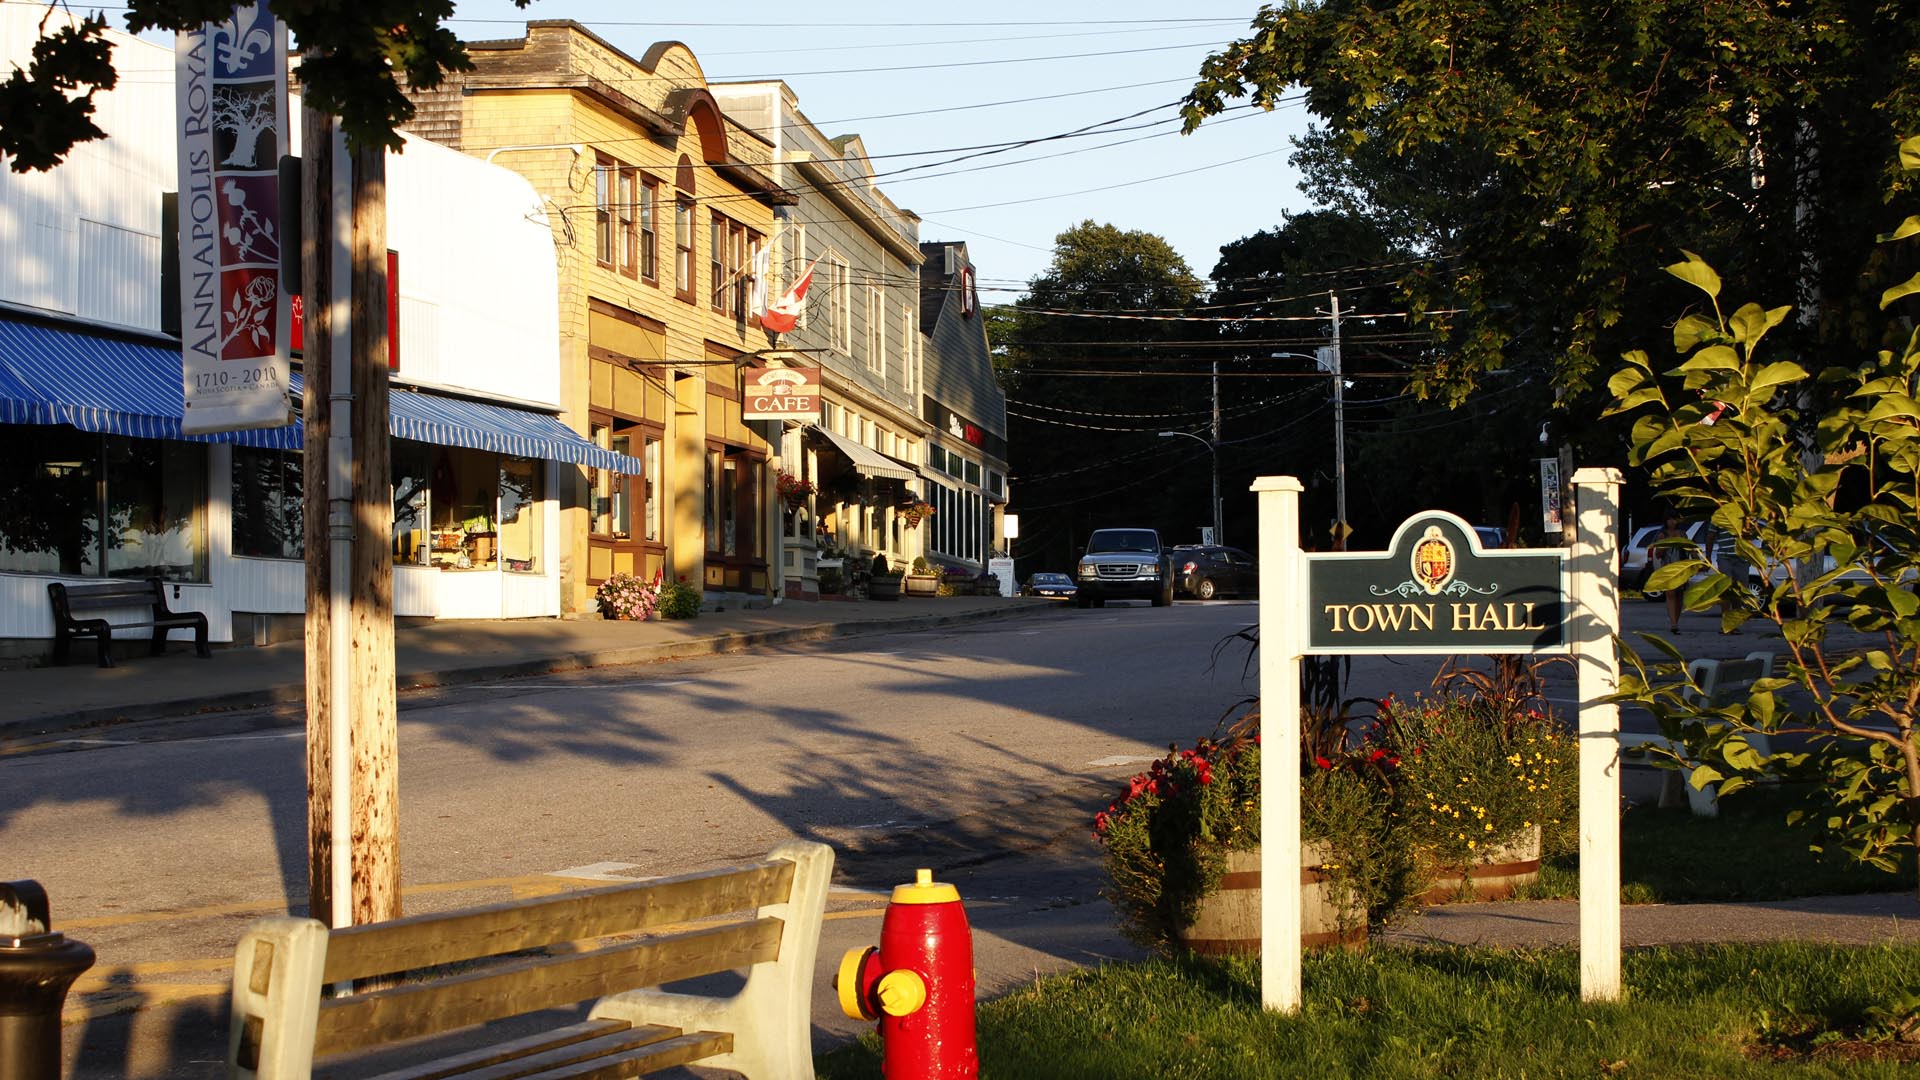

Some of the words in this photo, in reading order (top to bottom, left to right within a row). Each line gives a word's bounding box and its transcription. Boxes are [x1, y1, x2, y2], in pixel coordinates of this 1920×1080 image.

[184, 20, 210, 139] ROYAL
[189, 150, 218, 361] ANNAPOLIS
[754, 397, 811, 412] CAFE
[1324, 602, 1435, 633] TOWN
[1450, 602, 1545, 632] HALL
